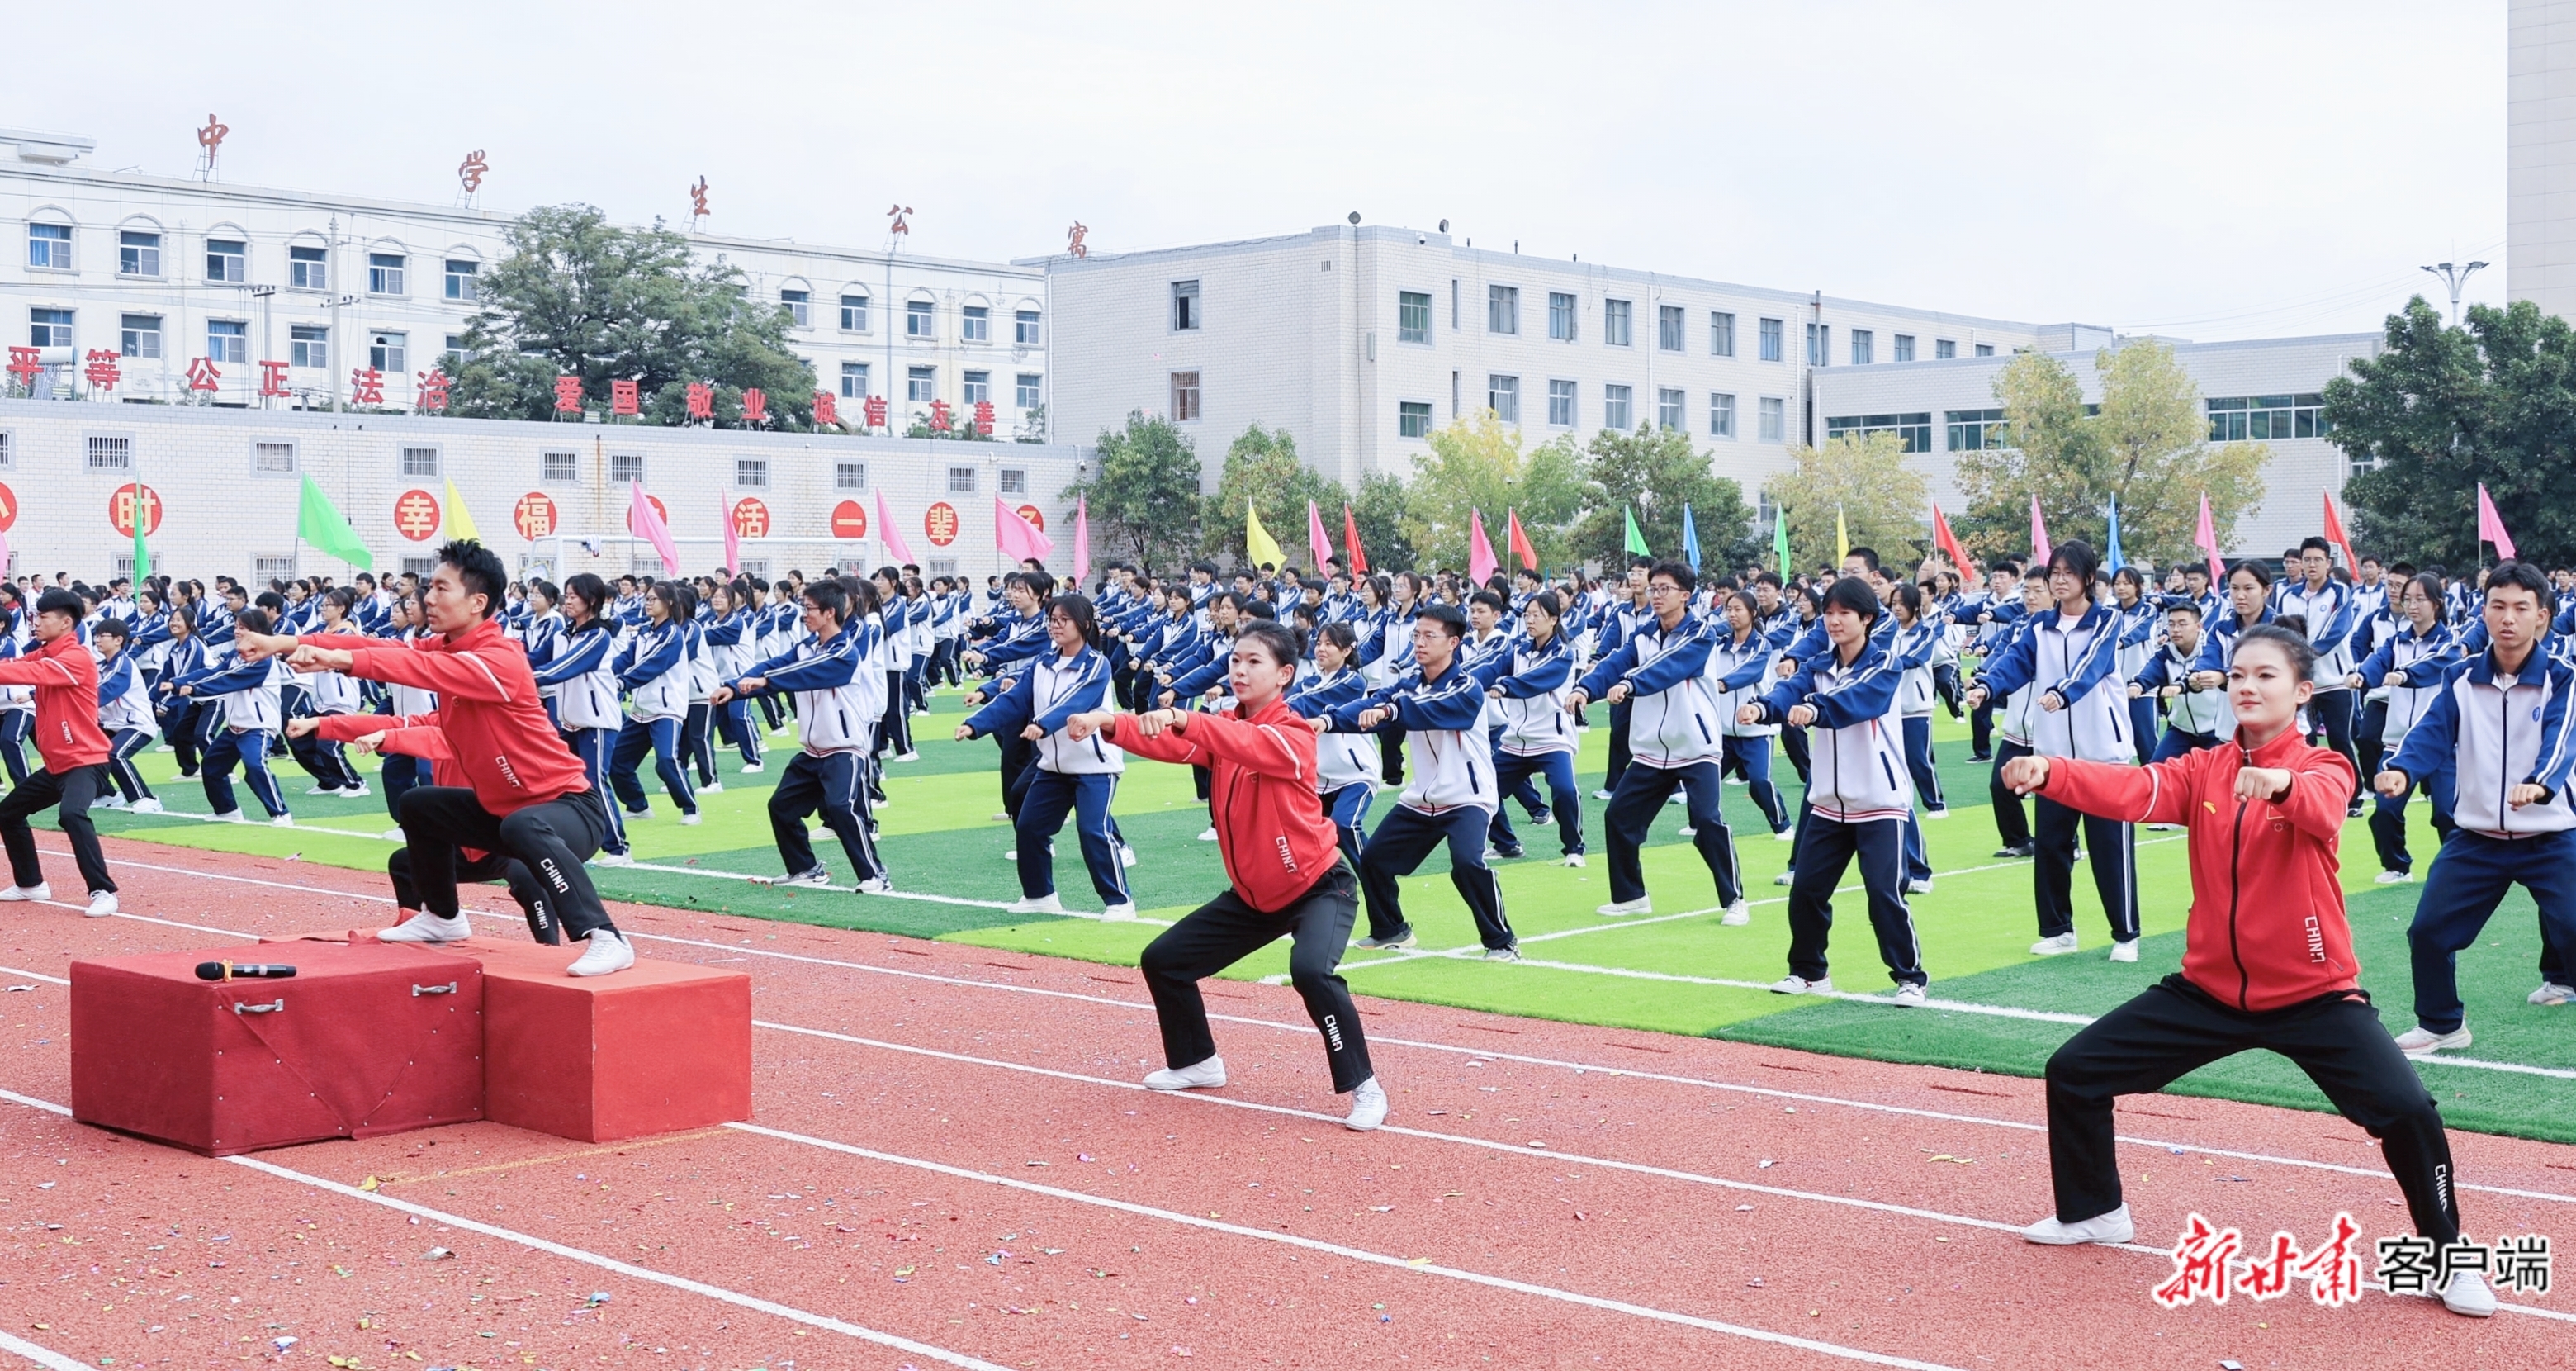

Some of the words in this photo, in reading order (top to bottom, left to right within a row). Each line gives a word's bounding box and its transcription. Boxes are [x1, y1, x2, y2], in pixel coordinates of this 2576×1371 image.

[495, 755, 521, 788] CHINA
[1276, 836, 1298, 873] CHINA
[540, 858, 569, 894] CHINA
[533, 900, 549, 930] CHINA
[2305, 916, 2326, 963] CHINA
[1324, 1014, 1344, 1051] CHINA
